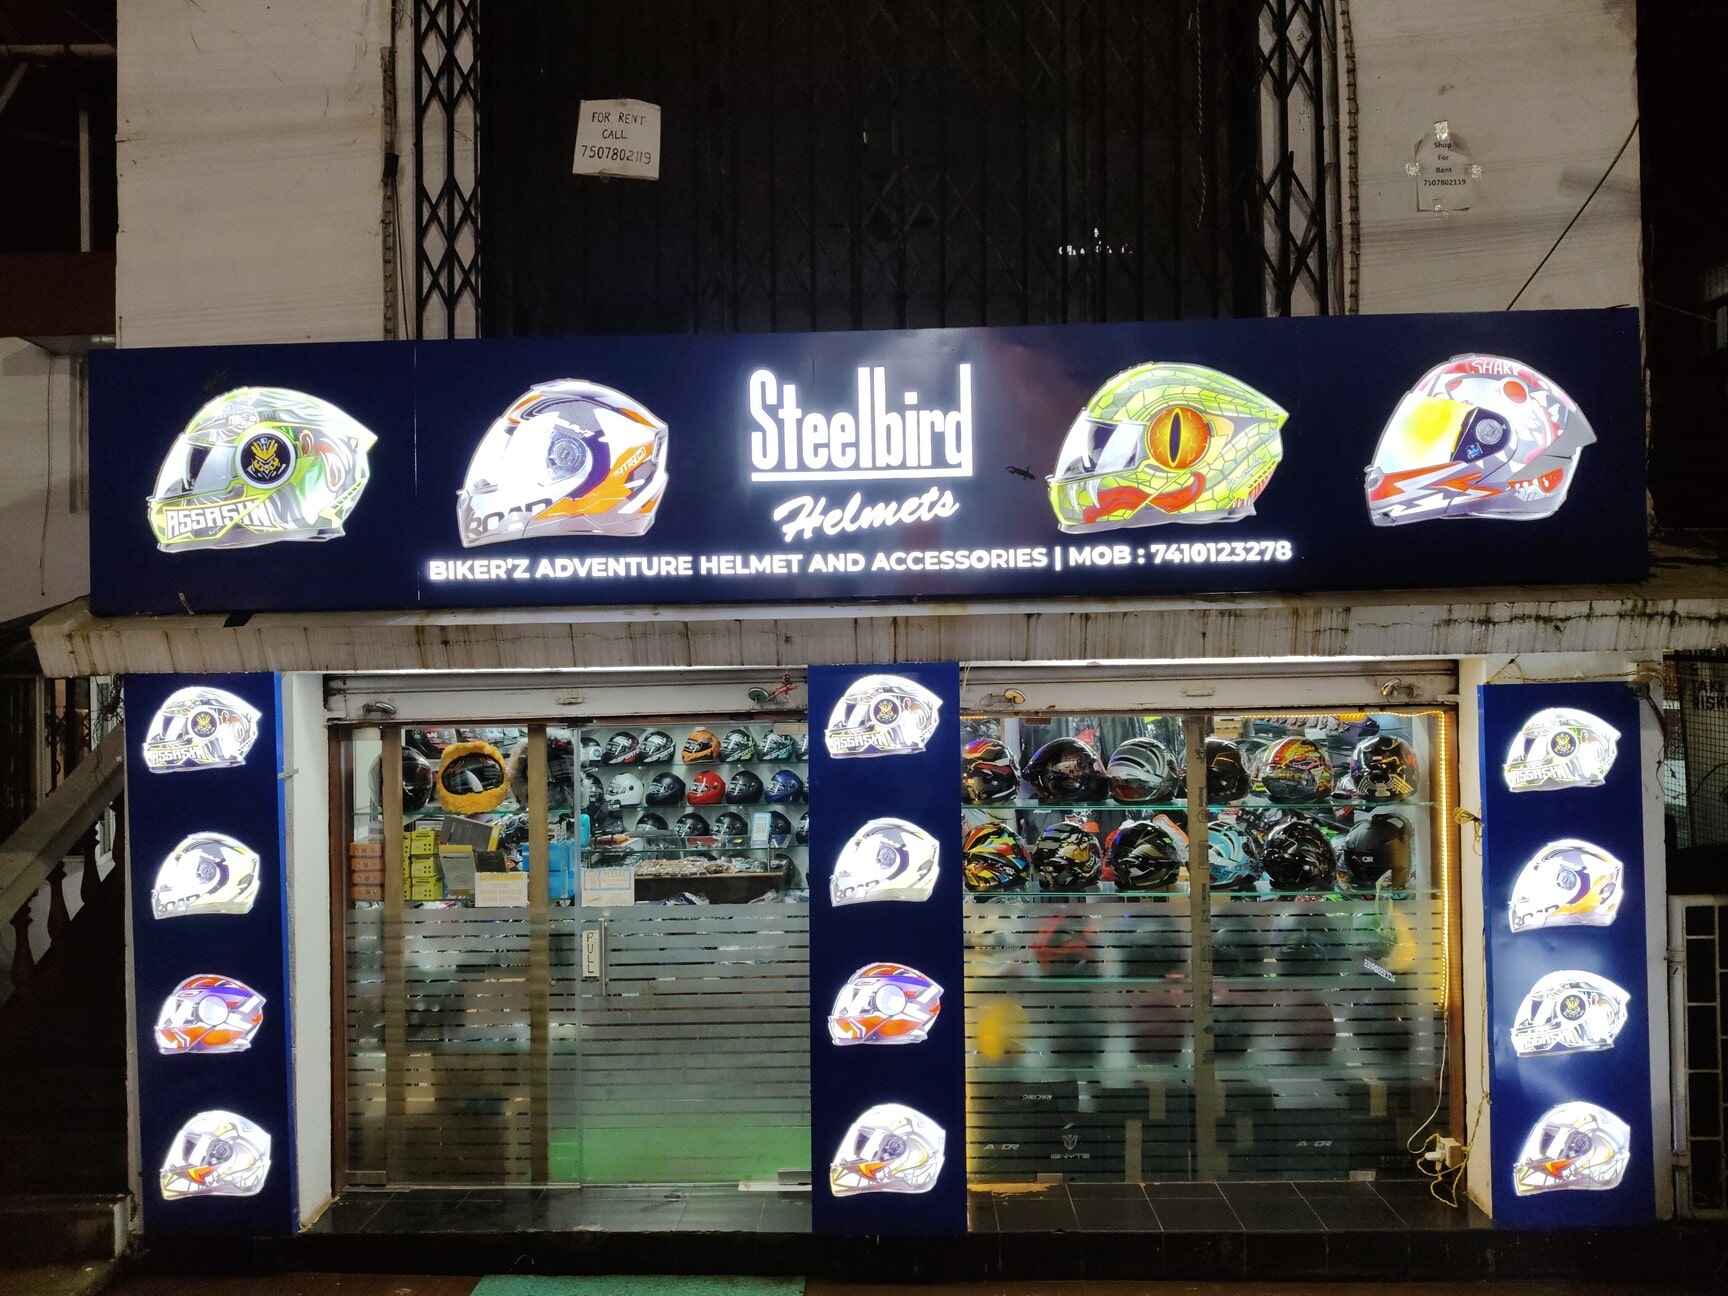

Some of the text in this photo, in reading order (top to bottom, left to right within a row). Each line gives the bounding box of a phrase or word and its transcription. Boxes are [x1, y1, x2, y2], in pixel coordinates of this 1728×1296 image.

[592, 112, 646, 125] FOR RENT
[602, 129, 628, 139] CALL
[581, 145, 652, 164] 7507802119
[1424, 179, 1467, 187] 7507802119
[751, 363, 973, 471] Steelbird
[165, 501, 275, 540] ASSASIN
[772, 487, 960, 543] Helmets
[534, 554, 693, 579] ADVENTURE
[699, 553, 803, 576] HELMET
[807, 552, 864, 574] AND
[870, 546, 1048, 573] ACCESSORIES
[1150, 540, 1293, 564] 7410123278
